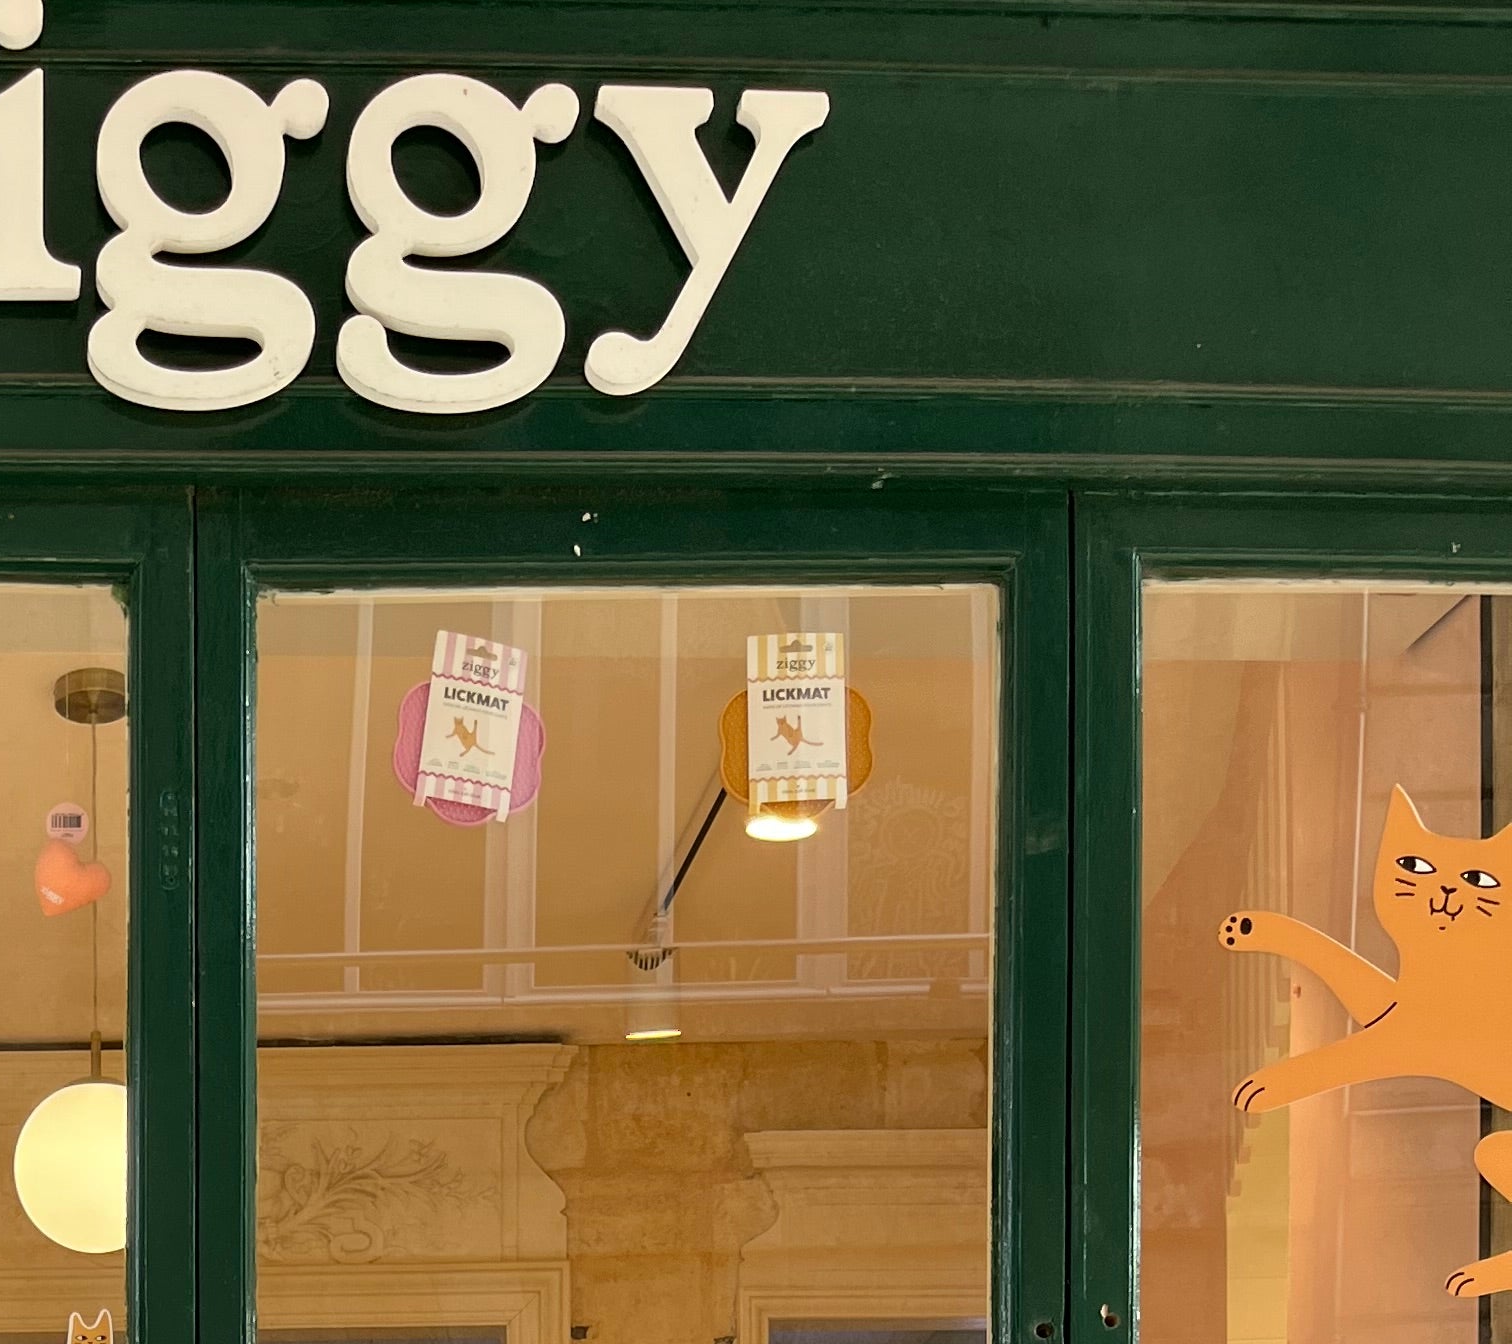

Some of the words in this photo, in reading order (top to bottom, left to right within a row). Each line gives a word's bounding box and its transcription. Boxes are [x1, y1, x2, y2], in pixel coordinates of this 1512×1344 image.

[461, 660, 500, 679] ziggy
[776, 658, 816, 672] ziggy
[443, 686, 510, 712] LICKMAT
[762, 687, 832, 702] LICKMAT
